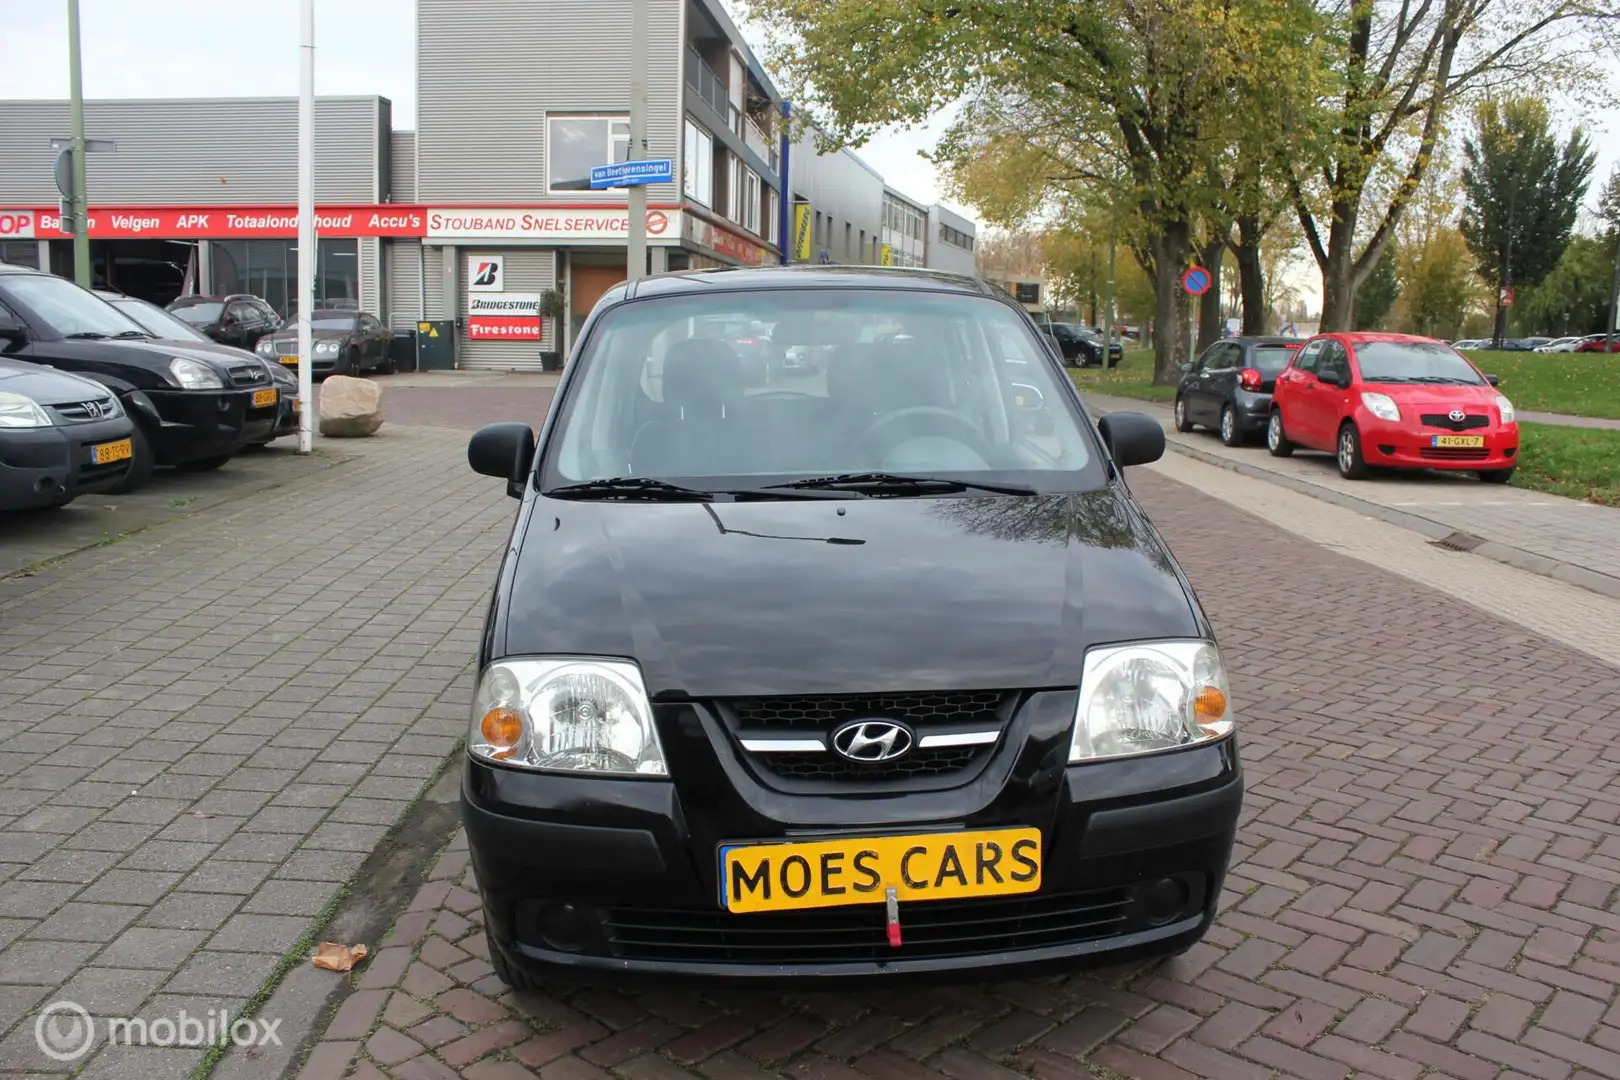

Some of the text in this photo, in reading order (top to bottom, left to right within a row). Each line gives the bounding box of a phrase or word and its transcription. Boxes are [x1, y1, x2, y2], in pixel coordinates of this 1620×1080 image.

[594, 170, 606, 179] van
[112, 215, 160, 232] Velgen
[176, 215, 209, 229] APK
[226, 214, 352, 229] Totaalondhoud
[368, 213, 421, 228] Accu's
[430, 214, 629, 230] STOUBAND SNELSERVICE
[471, 299, 539, 310] BRIDGESTONE
[470, 323, 540, 336] Firestone
[732, 839, 1038, 903] MOES CARS
